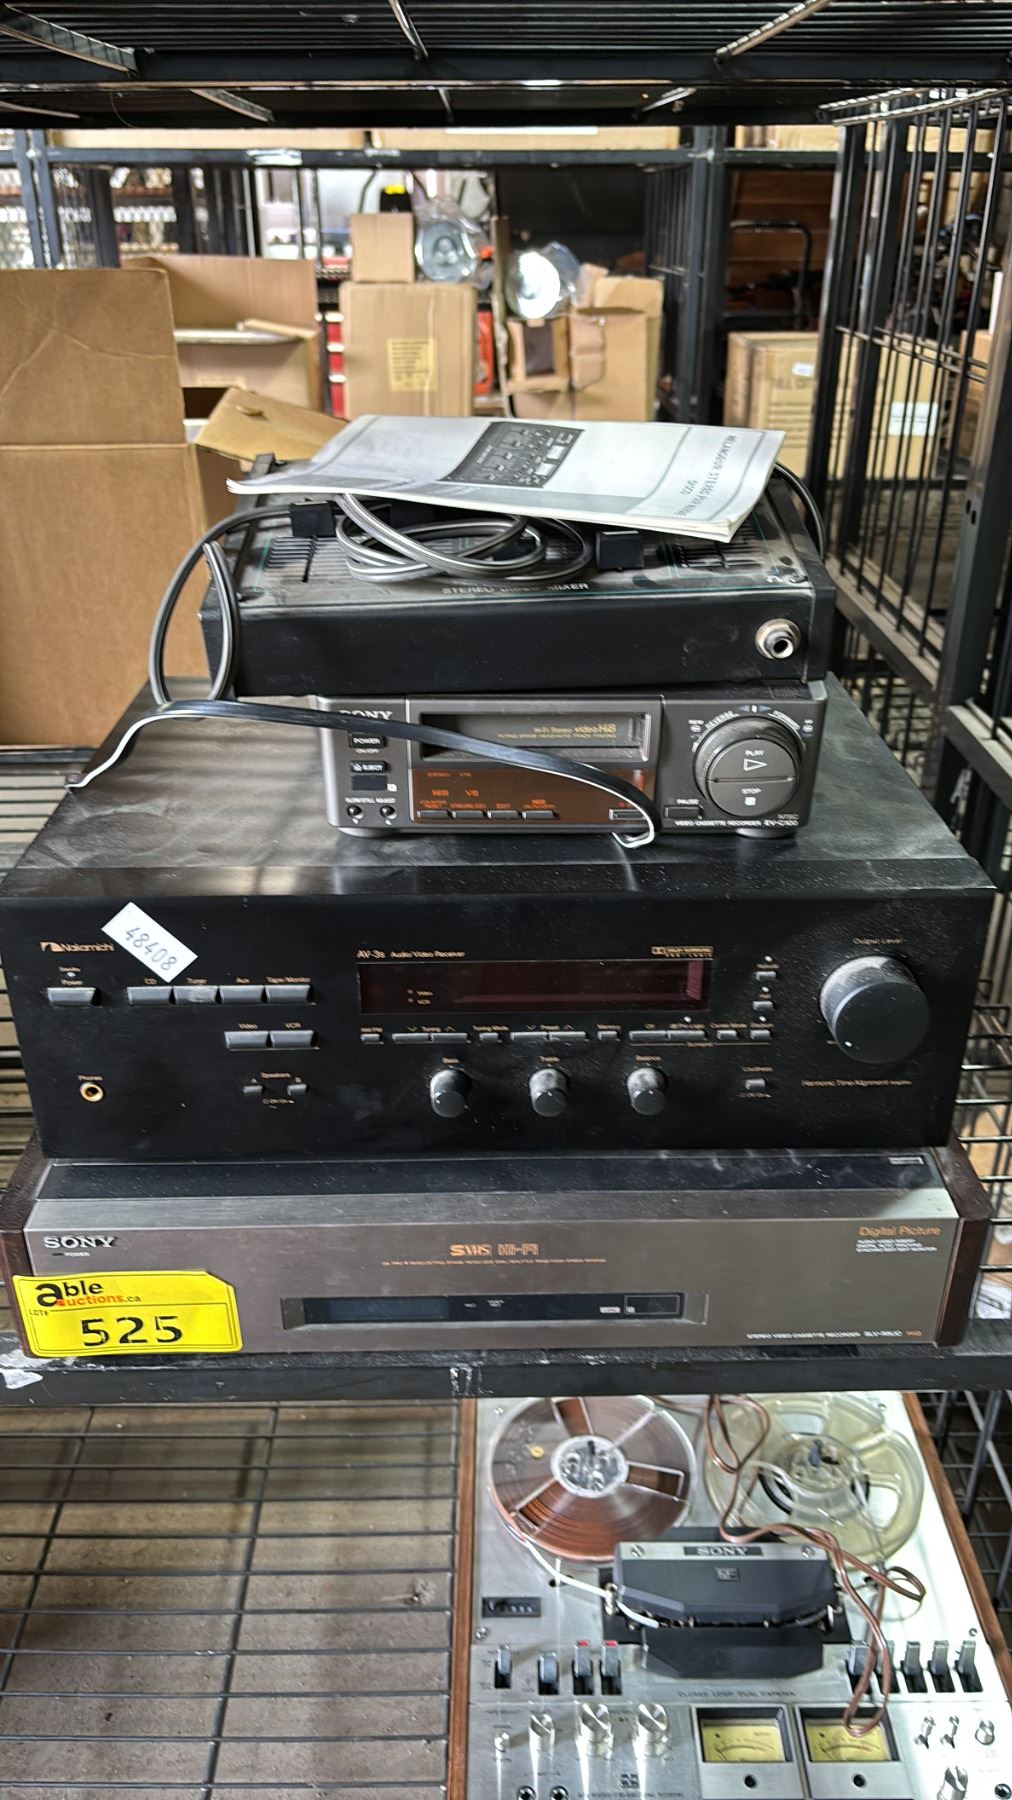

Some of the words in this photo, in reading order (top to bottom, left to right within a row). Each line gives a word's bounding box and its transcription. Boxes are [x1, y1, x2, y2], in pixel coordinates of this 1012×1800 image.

[61, 942, 114, 952] Nakamichi
[124, 927, 177, 971] 48408
[434, 950, 465, 958] Receiver
[858, 1226, 897, 1237] Digital
[899, 1226, 942, 1235] Picture
[43, 1236, 114, 1249] SONY
[80, 1315, 184, 1347] 525
[697, 1545, 748, 1556] SONY
